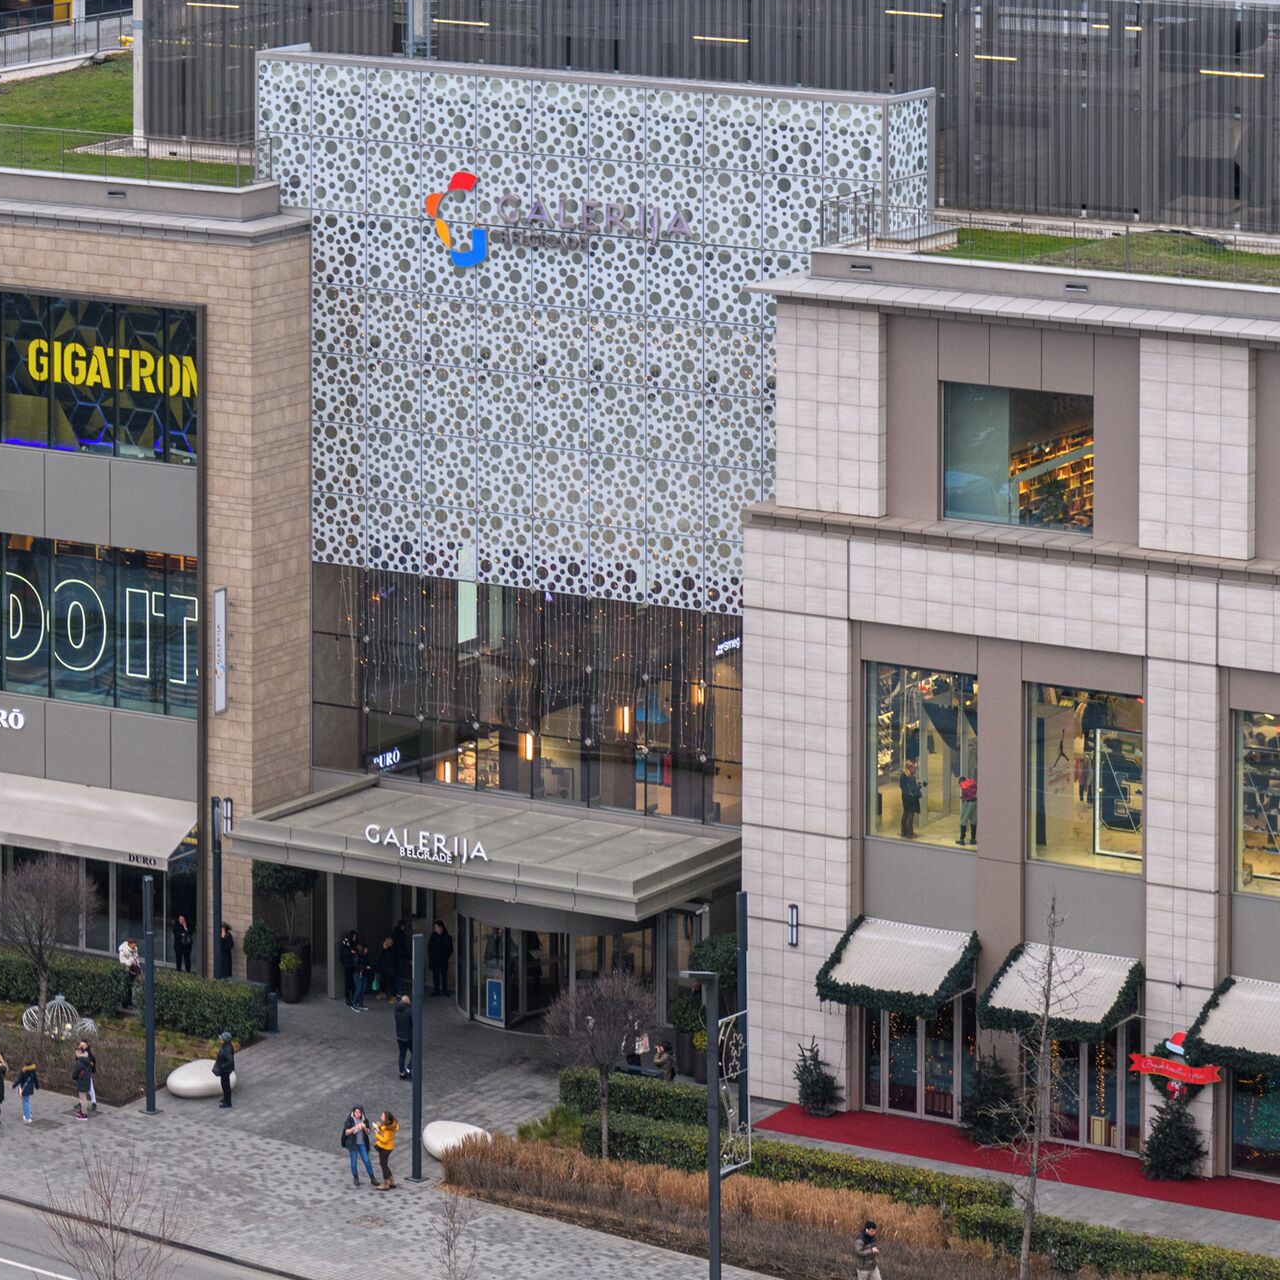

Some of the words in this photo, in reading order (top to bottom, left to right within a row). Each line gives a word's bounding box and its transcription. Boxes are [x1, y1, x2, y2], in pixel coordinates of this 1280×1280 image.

[496, 193, 694, 245] GALERIJA
[498, 228, 590, 253] BELGRADE
[27, 338, 198, 398] GIGATRON
[365, 823, 489, 864] GALERIJA
[399, 847, 453, 864] BELGRADE
